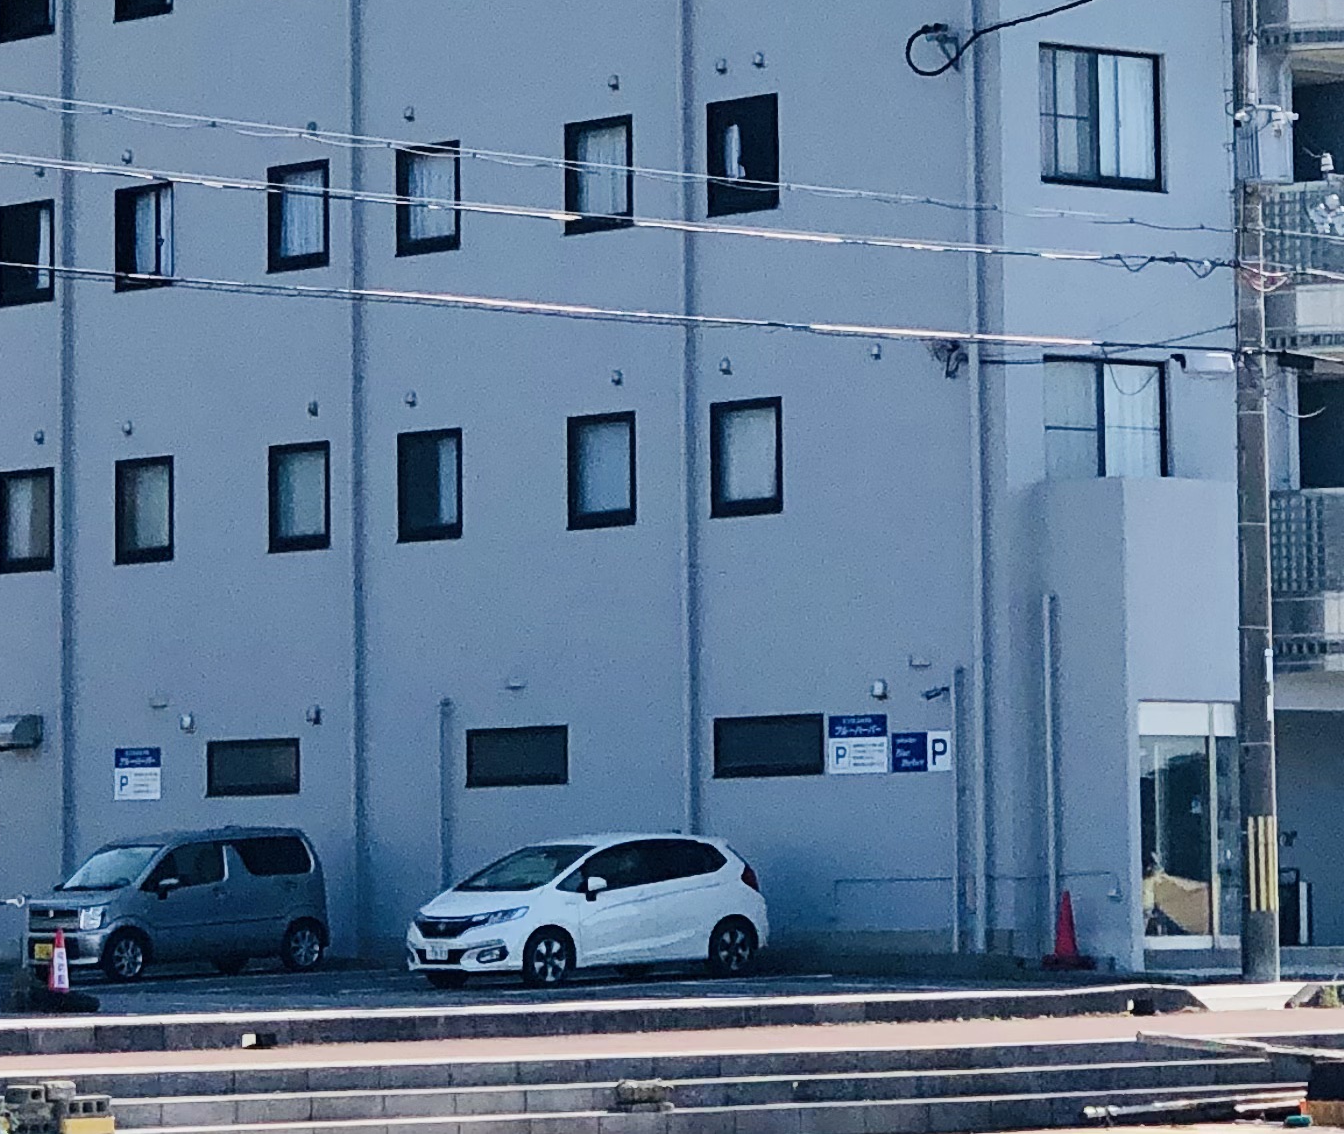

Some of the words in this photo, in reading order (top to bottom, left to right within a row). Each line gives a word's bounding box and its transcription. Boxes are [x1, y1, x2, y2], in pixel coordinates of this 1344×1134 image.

[836, 746, 847, 765] P
[932, 738, 948, 765] P
[120, 775, 129, 792] P
